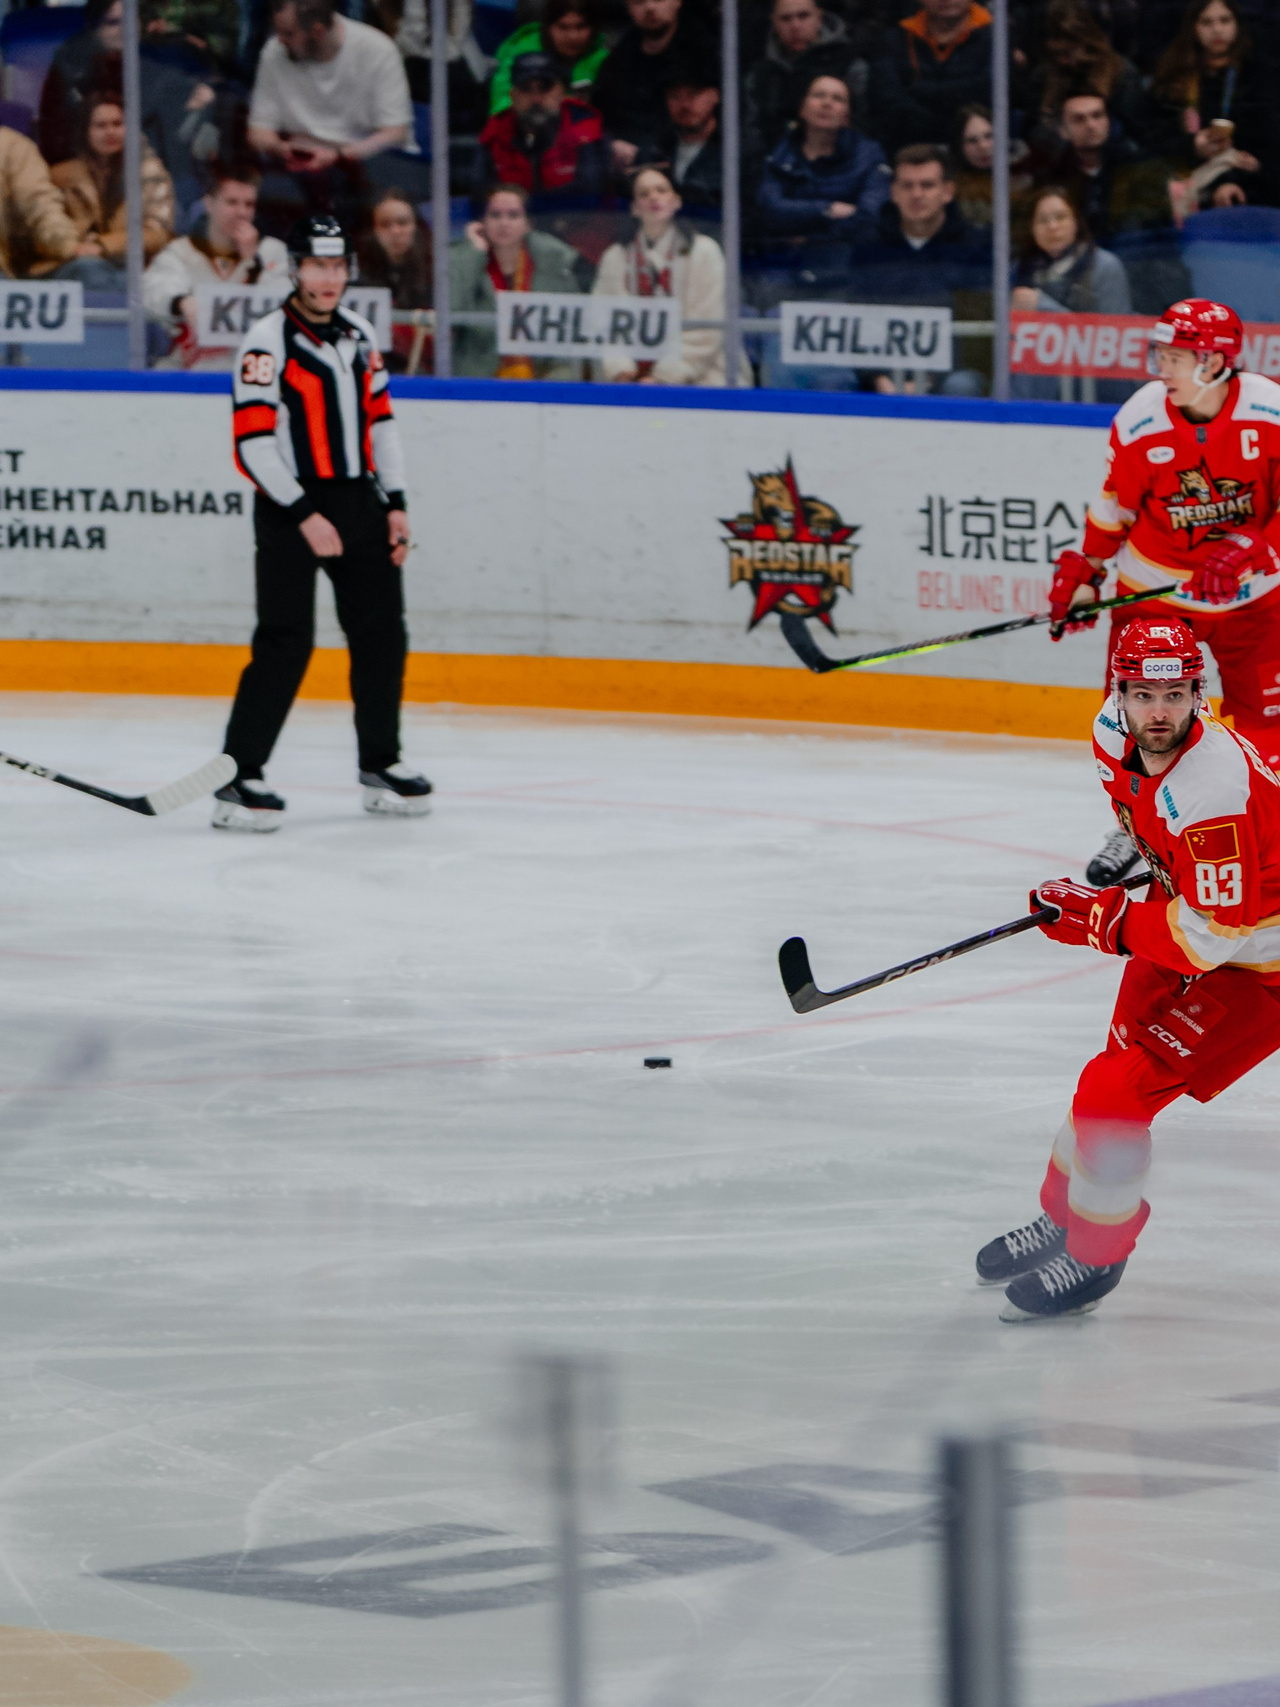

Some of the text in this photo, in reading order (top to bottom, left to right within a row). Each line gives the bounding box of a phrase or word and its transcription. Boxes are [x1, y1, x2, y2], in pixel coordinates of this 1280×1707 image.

[508, 304, 668, 348] KHL.RU
[793, 314, 940, 358] KHL.RU
[1011, 322, 1152, 371] FONBE
[241, 351, 275, 386] 38
[1240, 428, 1260, 461] C
[0, 487, 244, 516] НЕНТАЛЬНАЯ
[1166, 493, 1254, 531] REDSTAR
[0, 518, 107, 550] ЙНАЯ
[918, 494, 1091, 565] 北京昆仑
[721, 537, 861, 593] REDSTAR
[917, 570, 1004, 614] BEIJING
[1194, 862, 1243, 908] 83
[1147, 1023, 1193, 1058] CCM
